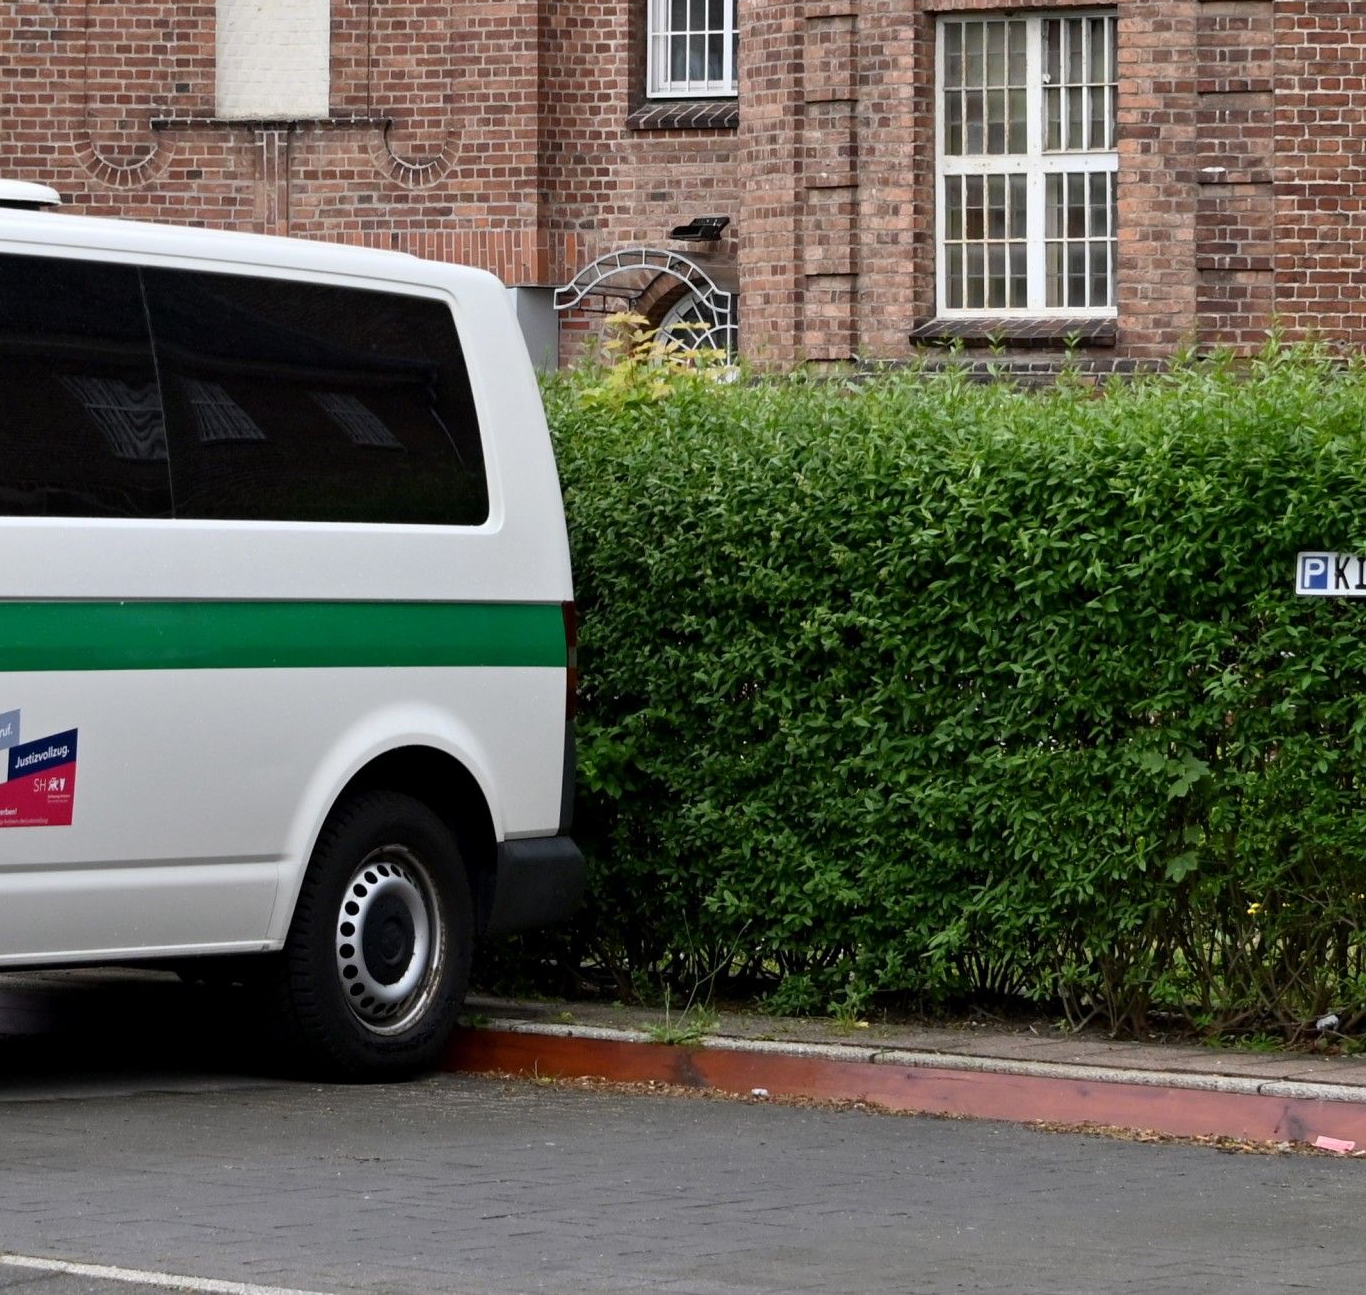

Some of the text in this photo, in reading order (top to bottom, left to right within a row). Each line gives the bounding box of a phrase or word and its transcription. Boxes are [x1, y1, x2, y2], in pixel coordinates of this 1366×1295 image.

[1304, 558, 1325, 588] P
[15, 745, 70, 769] Justizvollzug.
[33, 778, 47, 793] SH
